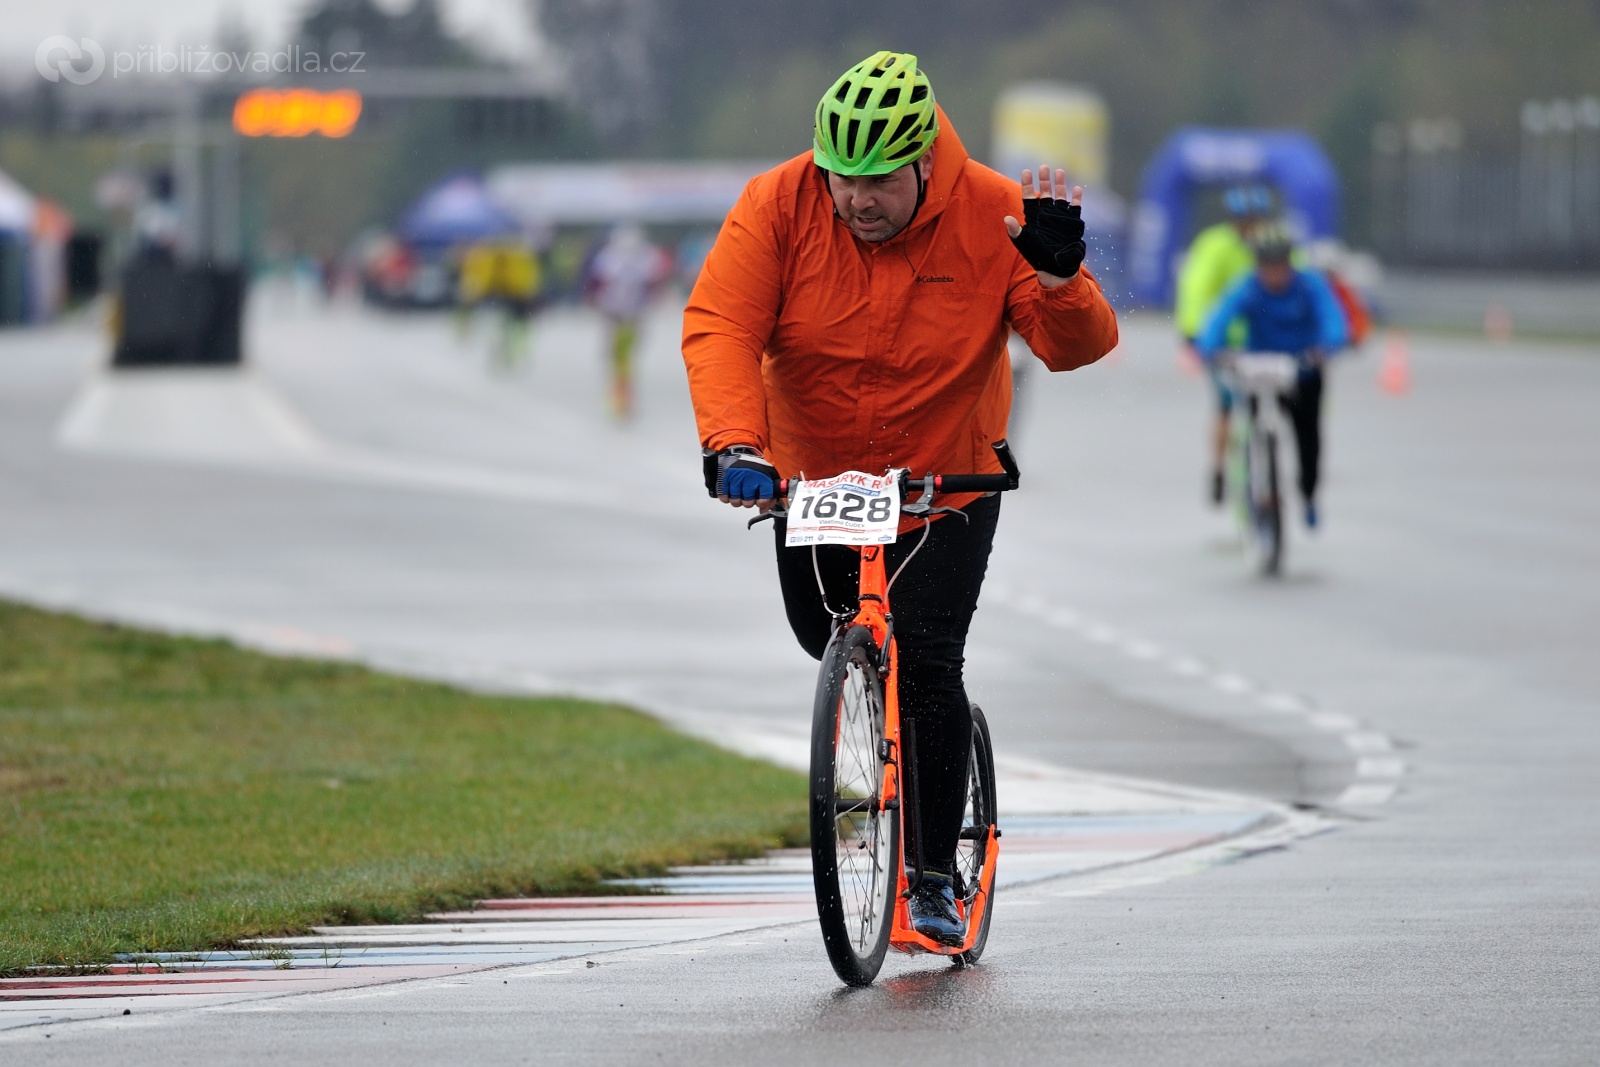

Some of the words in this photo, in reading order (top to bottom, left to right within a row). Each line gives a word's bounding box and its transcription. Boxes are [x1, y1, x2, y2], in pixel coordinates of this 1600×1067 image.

[921, 275, 954, 283] Columbia
[804, 474, 868, 488] MASARYK
[871, 475, 893, 489] RN
[801, 492, 891, 523] 1628
